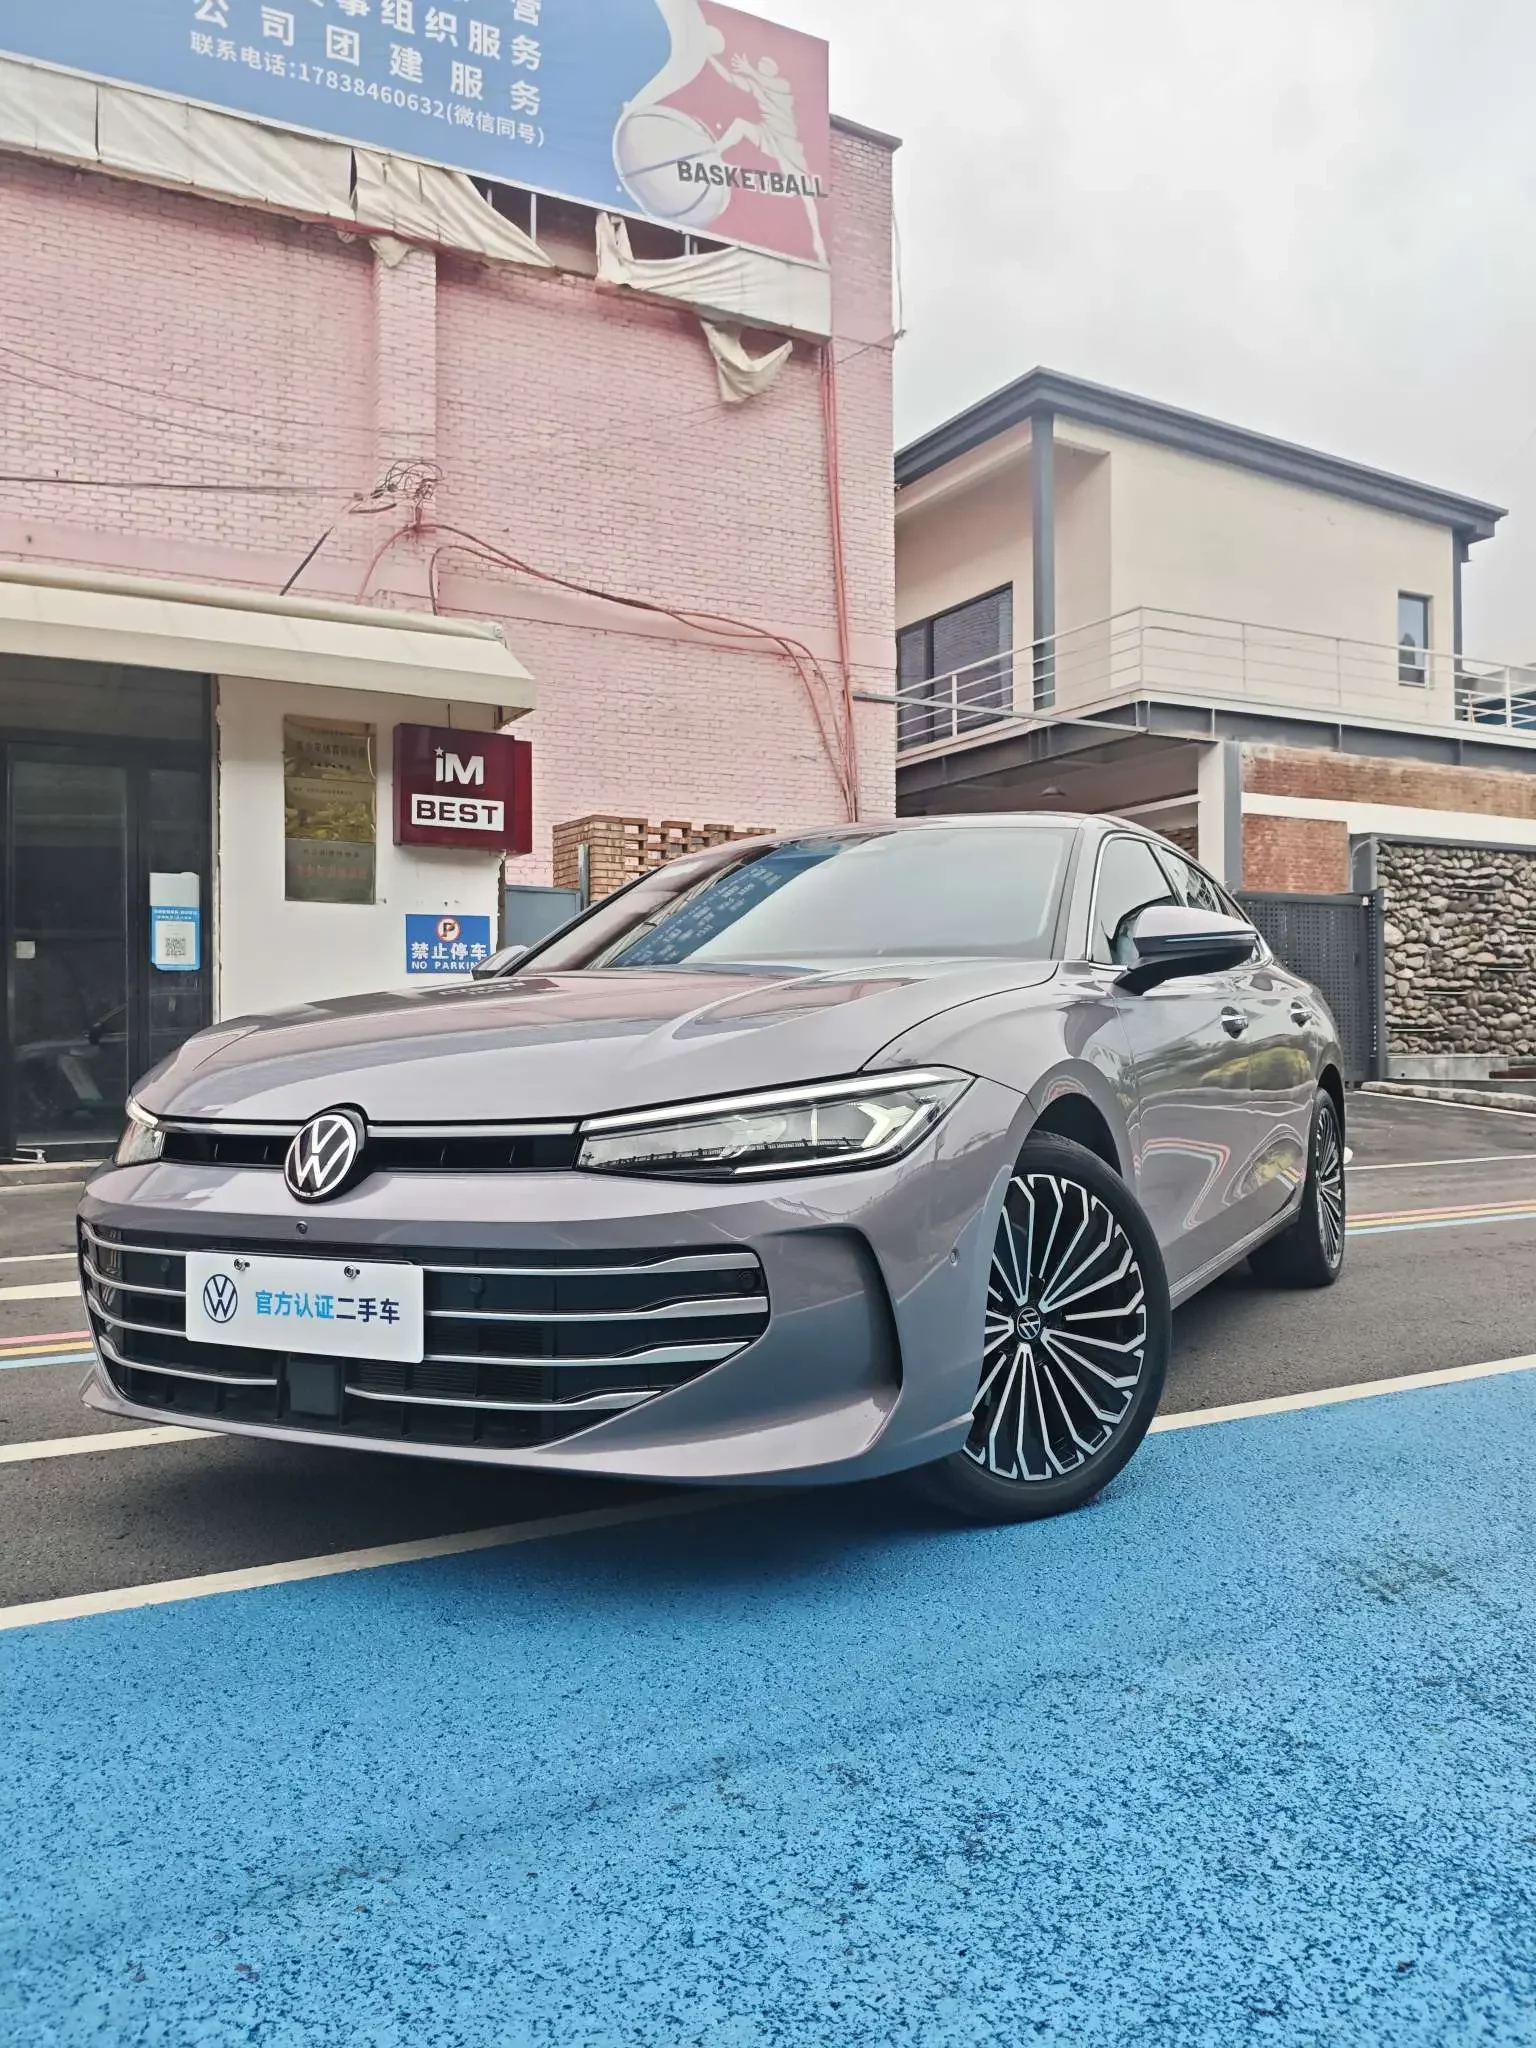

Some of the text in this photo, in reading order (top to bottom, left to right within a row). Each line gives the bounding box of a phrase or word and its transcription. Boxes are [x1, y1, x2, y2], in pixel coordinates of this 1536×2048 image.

[312, 0, 542, 71] 组织服务
[194, 0, 541, 116] 公司团建服务
[677, 159, 828, 198] BASKETBALL
[417, 800, 499, 825] BEST
[411, 942, 488, 961] 禁止停车
[411, 961, 479, 970] NO PARKIN
[255, 1290, 400, 1325] 官方认证二手车
